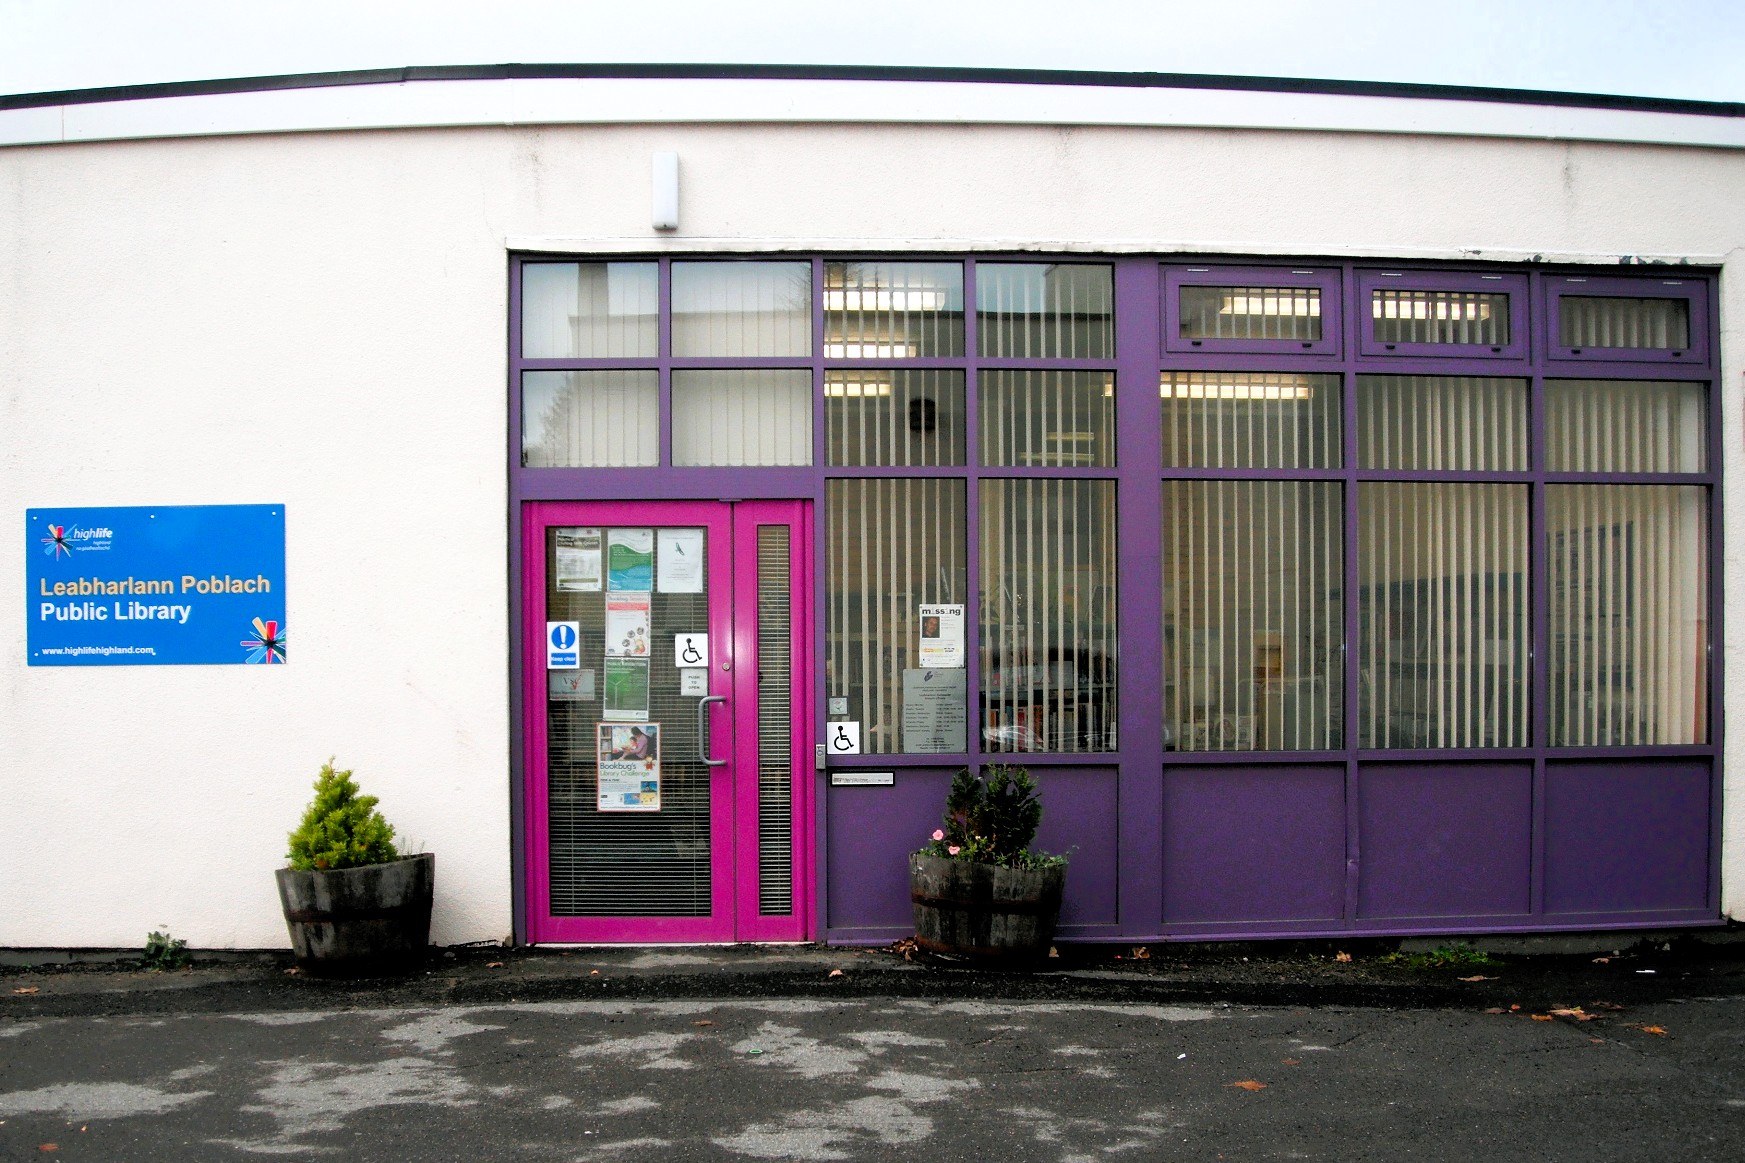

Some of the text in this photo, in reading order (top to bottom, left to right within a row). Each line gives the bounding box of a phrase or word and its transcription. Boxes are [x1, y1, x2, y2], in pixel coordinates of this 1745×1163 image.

[73, 527, 113, 541] highlife
[40, 575, 271, 596] Leabharlann Poblach
[40, 601, 191, 624] Public Library
[42, 645, 154, 657] www.highlifehighland.com
[599, 762, 636, 771] Bookbug's
